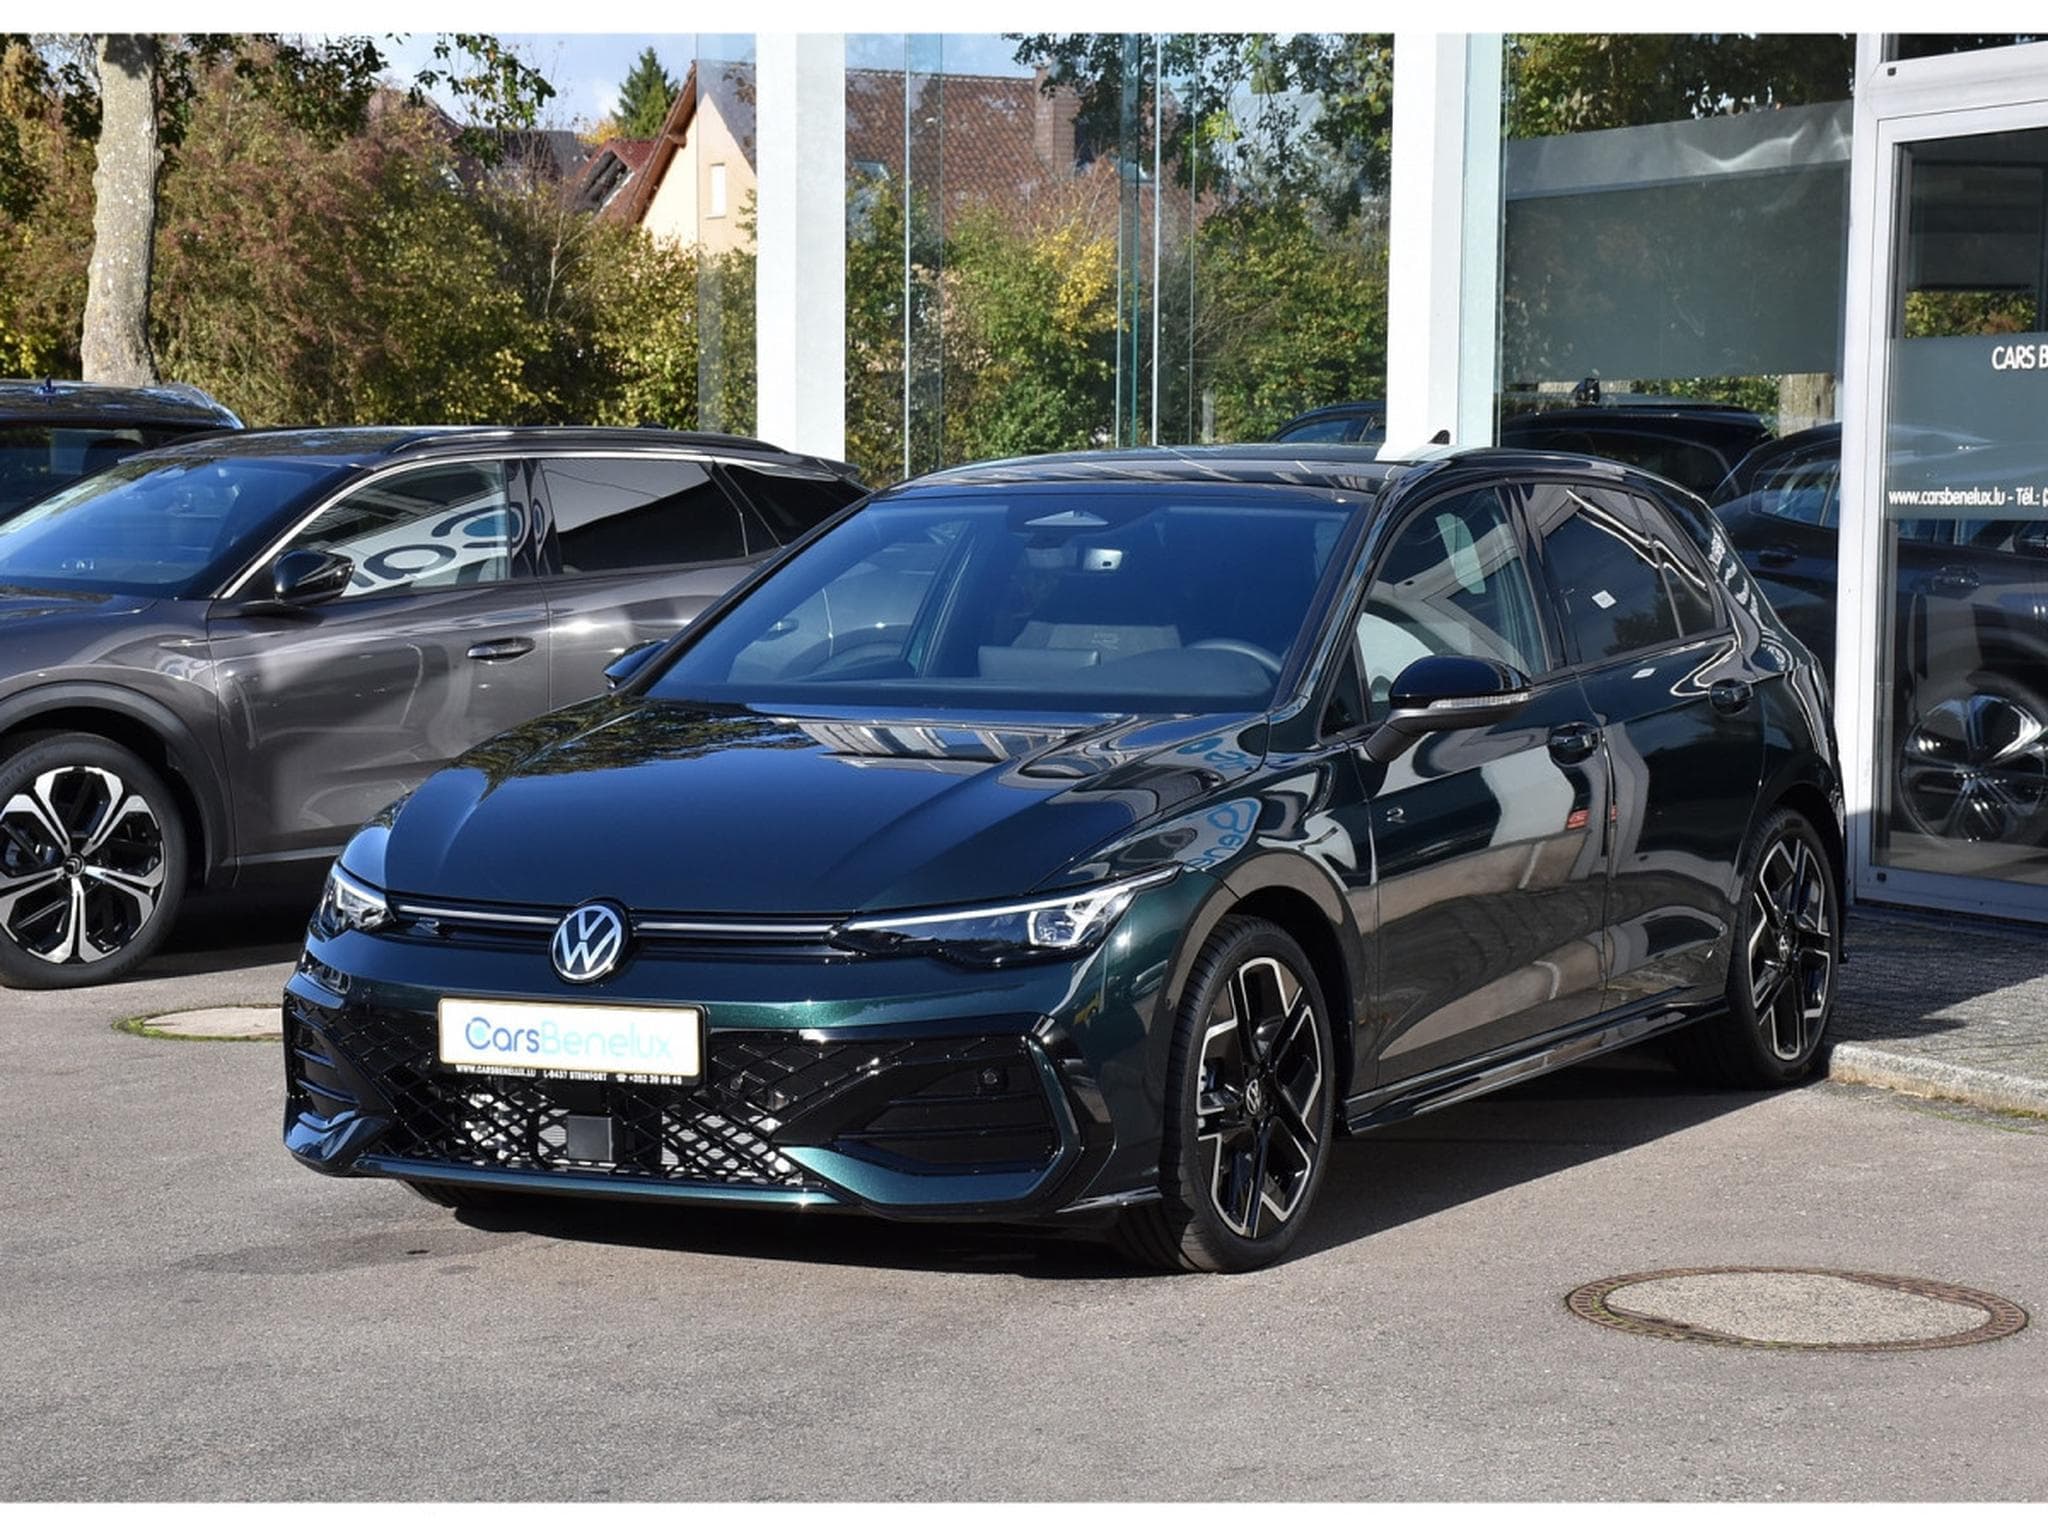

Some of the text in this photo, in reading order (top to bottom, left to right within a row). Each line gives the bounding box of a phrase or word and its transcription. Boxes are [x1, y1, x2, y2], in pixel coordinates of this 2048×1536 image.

[1991, 344, 2036, 370] CARS
[1888, 486, 2006, 506] www.carsbenelux.lu
[464, 1016, 673, 1060] CarsBenelux
